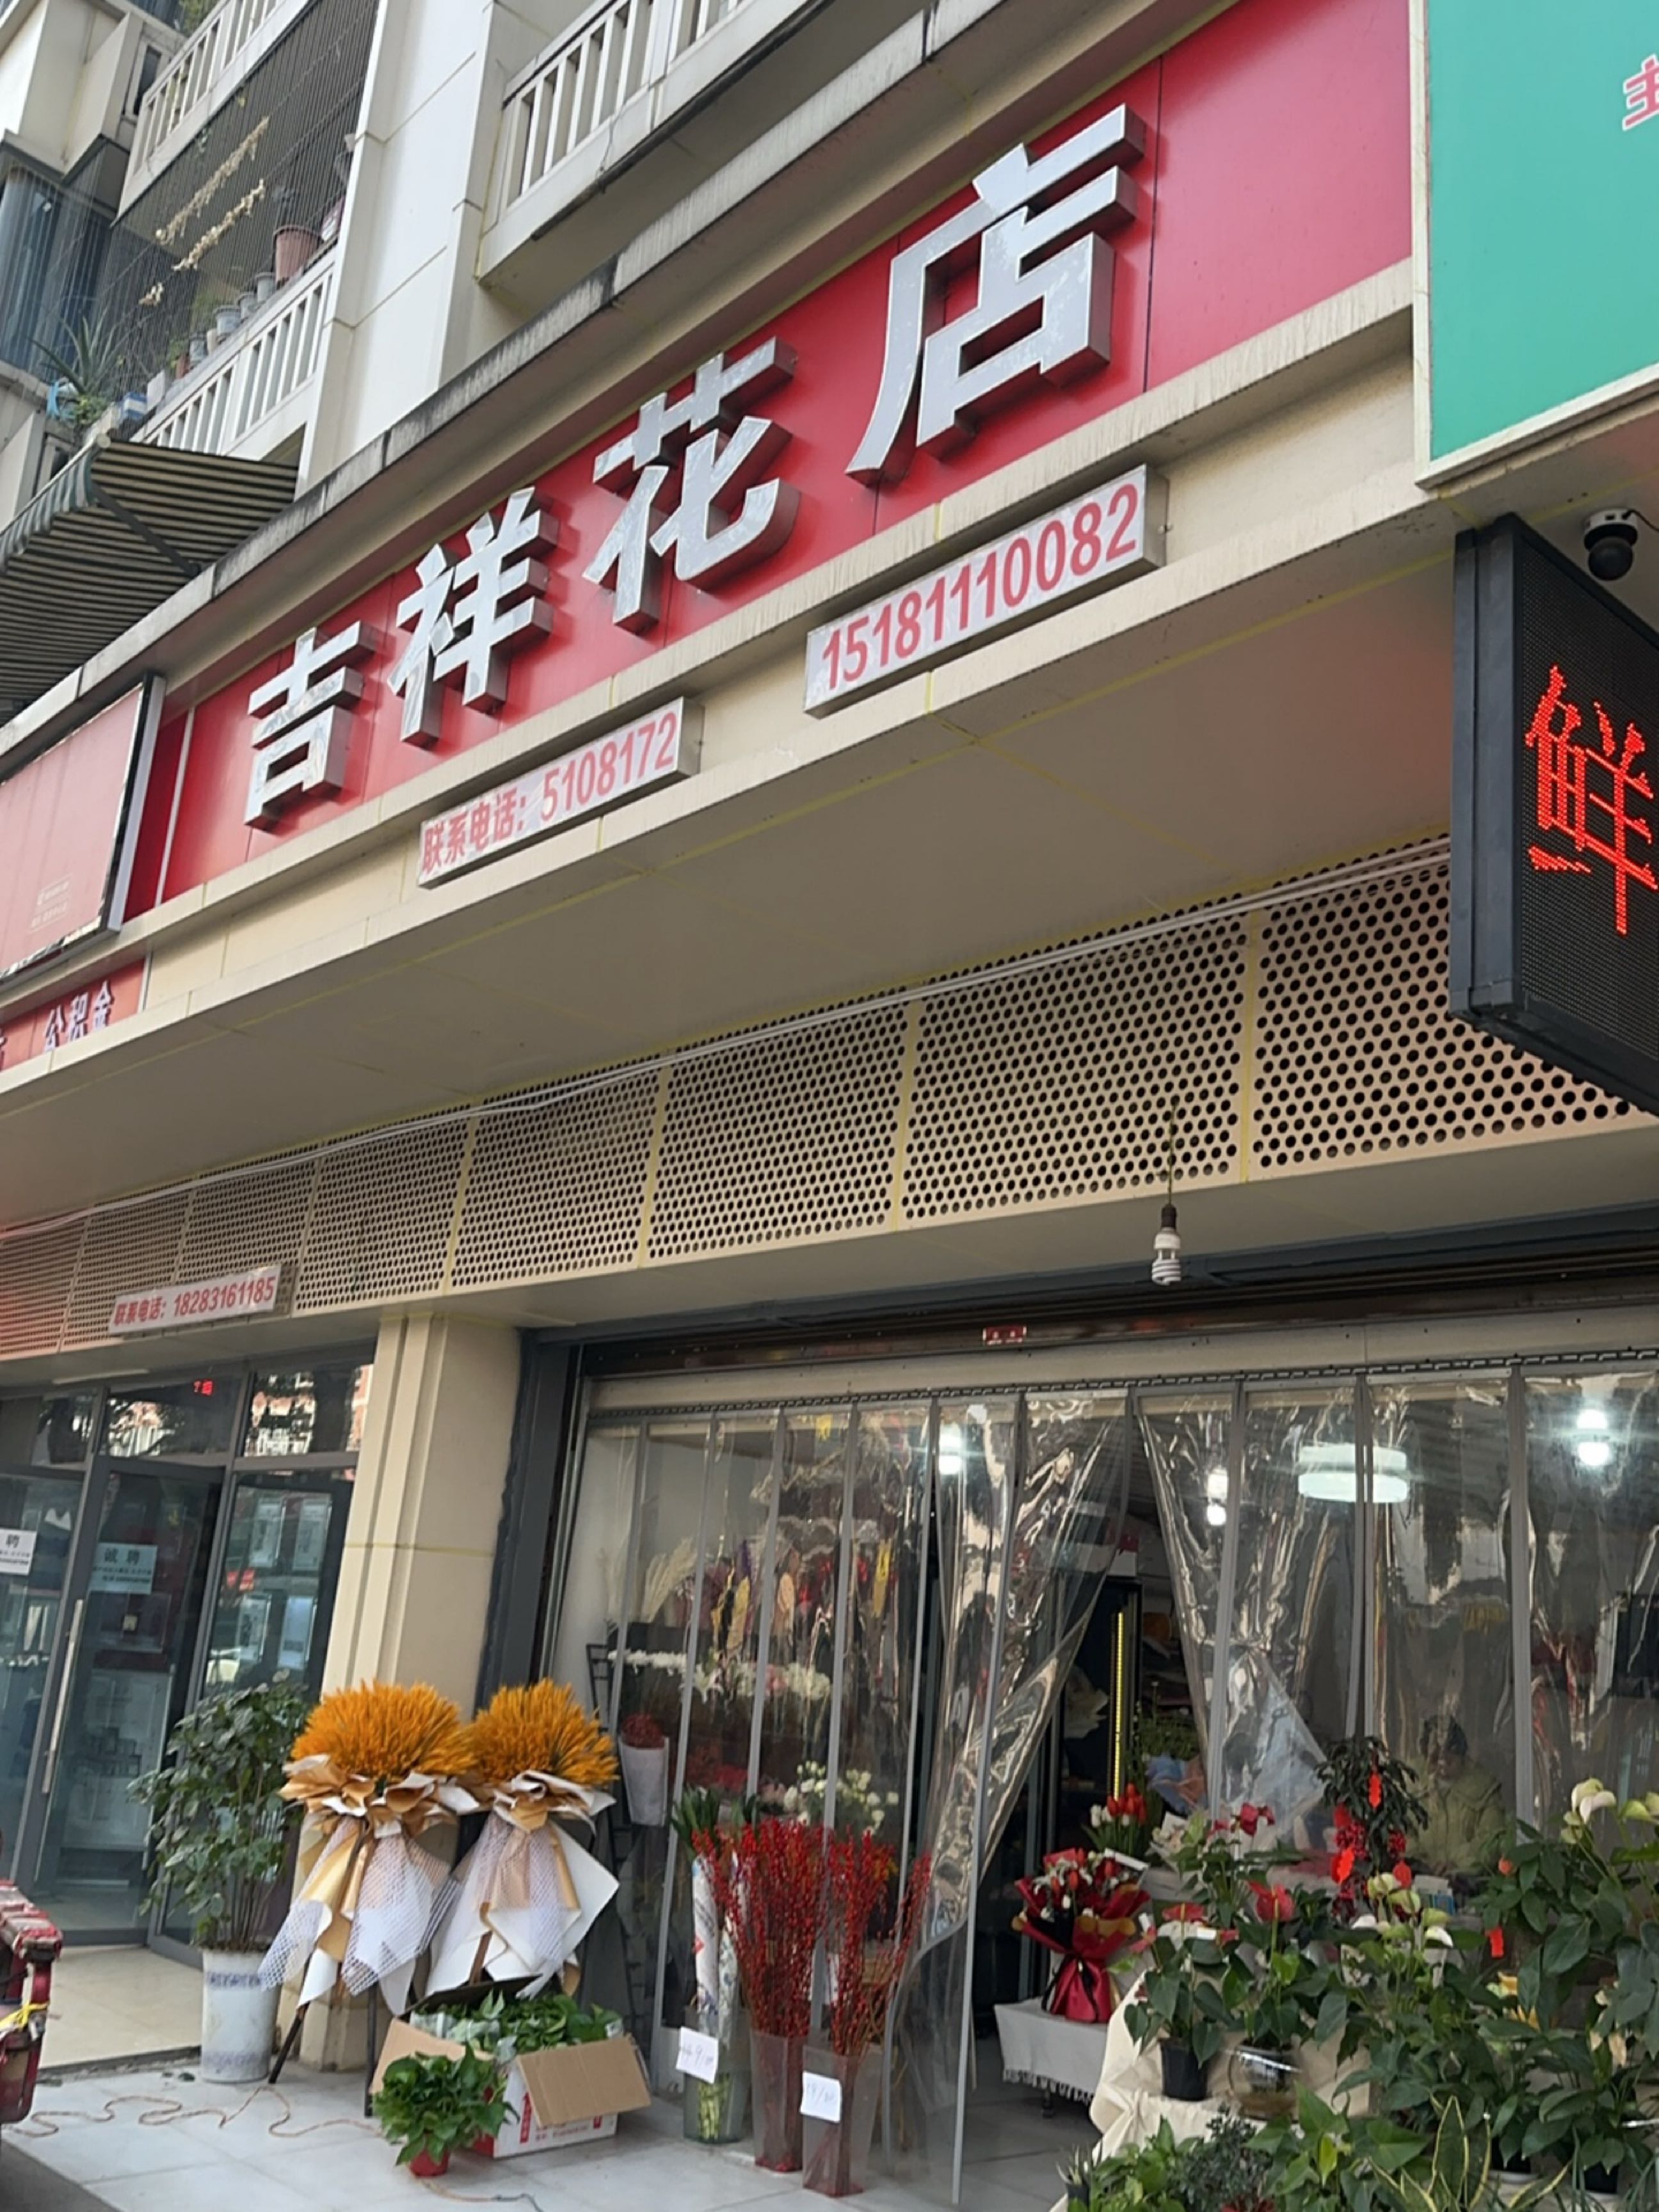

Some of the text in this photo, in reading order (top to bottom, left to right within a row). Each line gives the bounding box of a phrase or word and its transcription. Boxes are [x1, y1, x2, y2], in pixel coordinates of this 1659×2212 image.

[244, 103, 1135, 826] 吉祥花店
[822, 483, 1138, 689] 15181110082
[1524, 664, 1658, 936] 鲜
